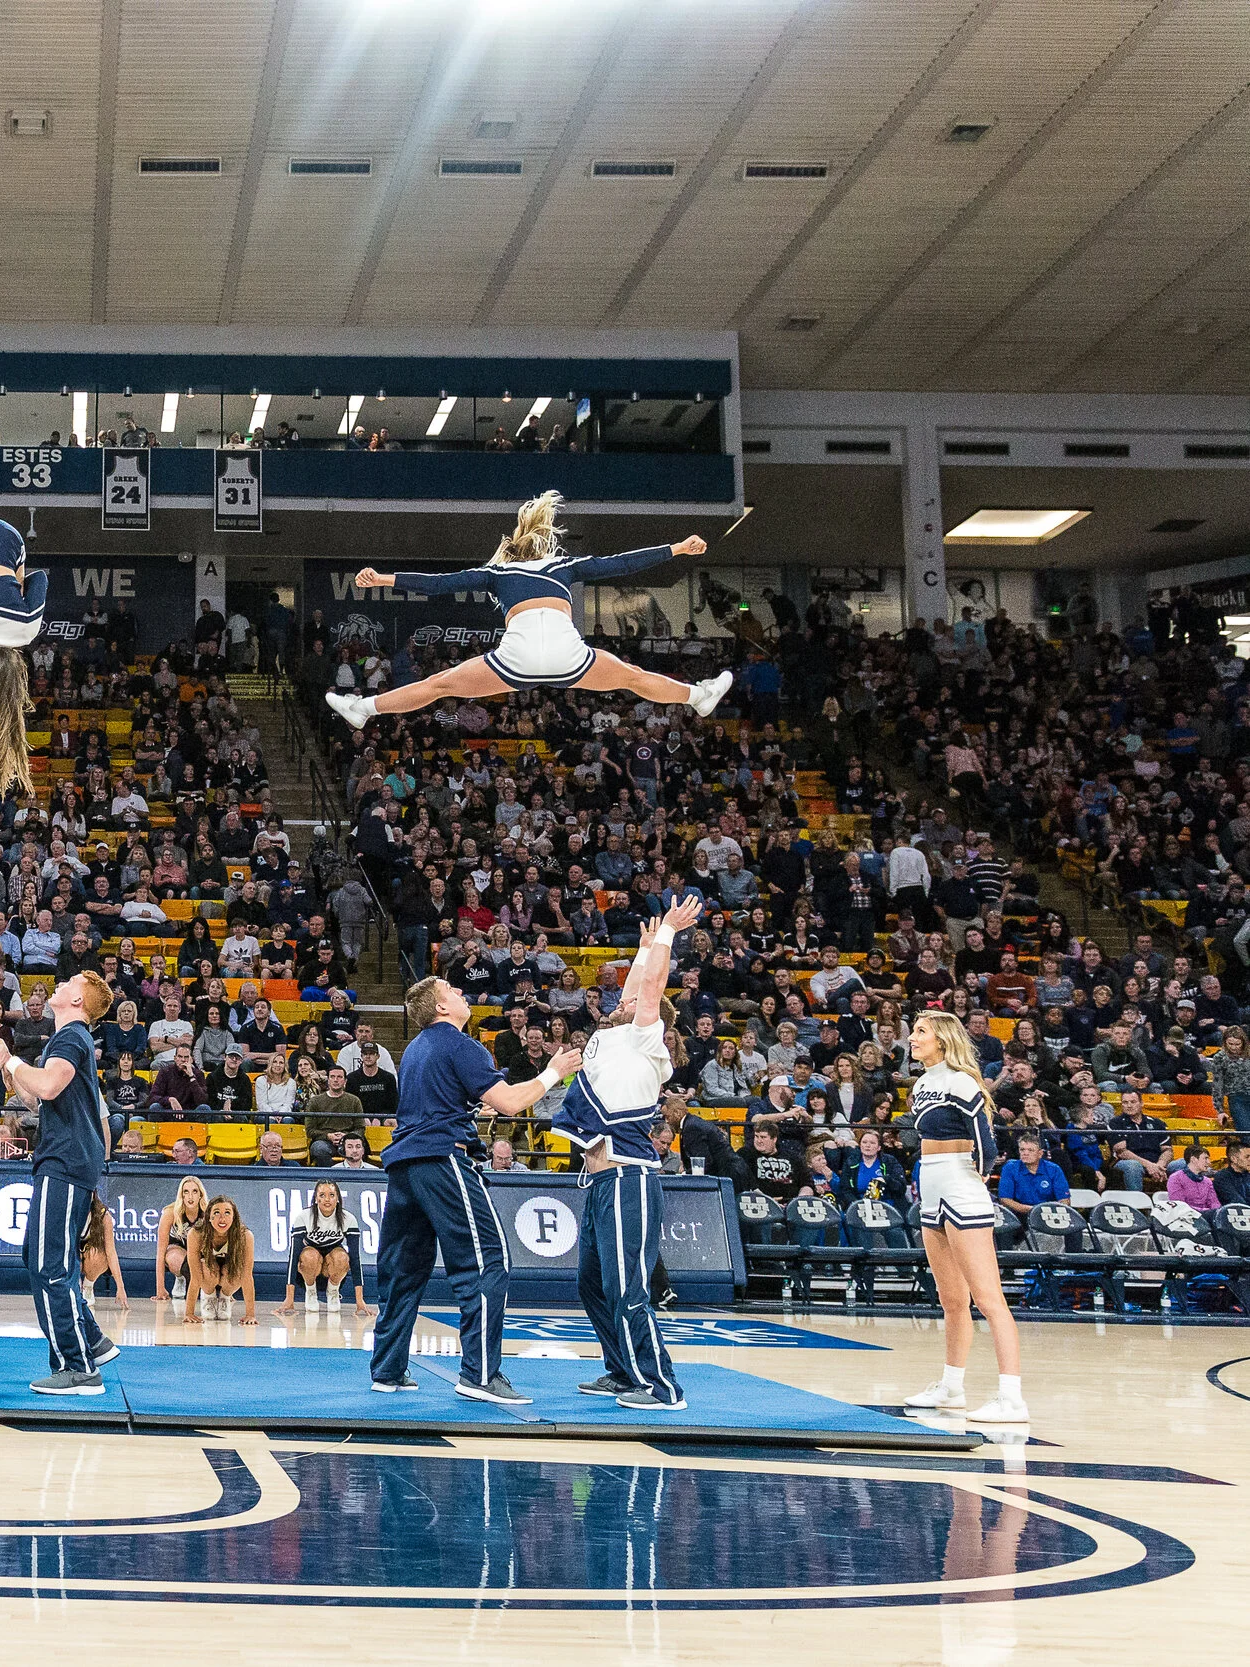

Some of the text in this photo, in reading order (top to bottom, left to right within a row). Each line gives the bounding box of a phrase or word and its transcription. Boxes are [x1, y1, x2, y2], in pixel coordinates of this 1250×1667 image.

[2, 448, 62, 463] ESTES
[11, 463, 52, 488] 33
[111, 486, 141, 504] 24
[225, 488, 251, 505] 31
[204, 561, 218, 576] A
[72, 568, 136, 597] WE
[923, 570, 938, 587] C
[466, 967, 490, 980] State
[8, 1197, 31, 1229] F
[308, 1226, 343, 1240] Aggies
[533, 1208, 558, 1243] F
